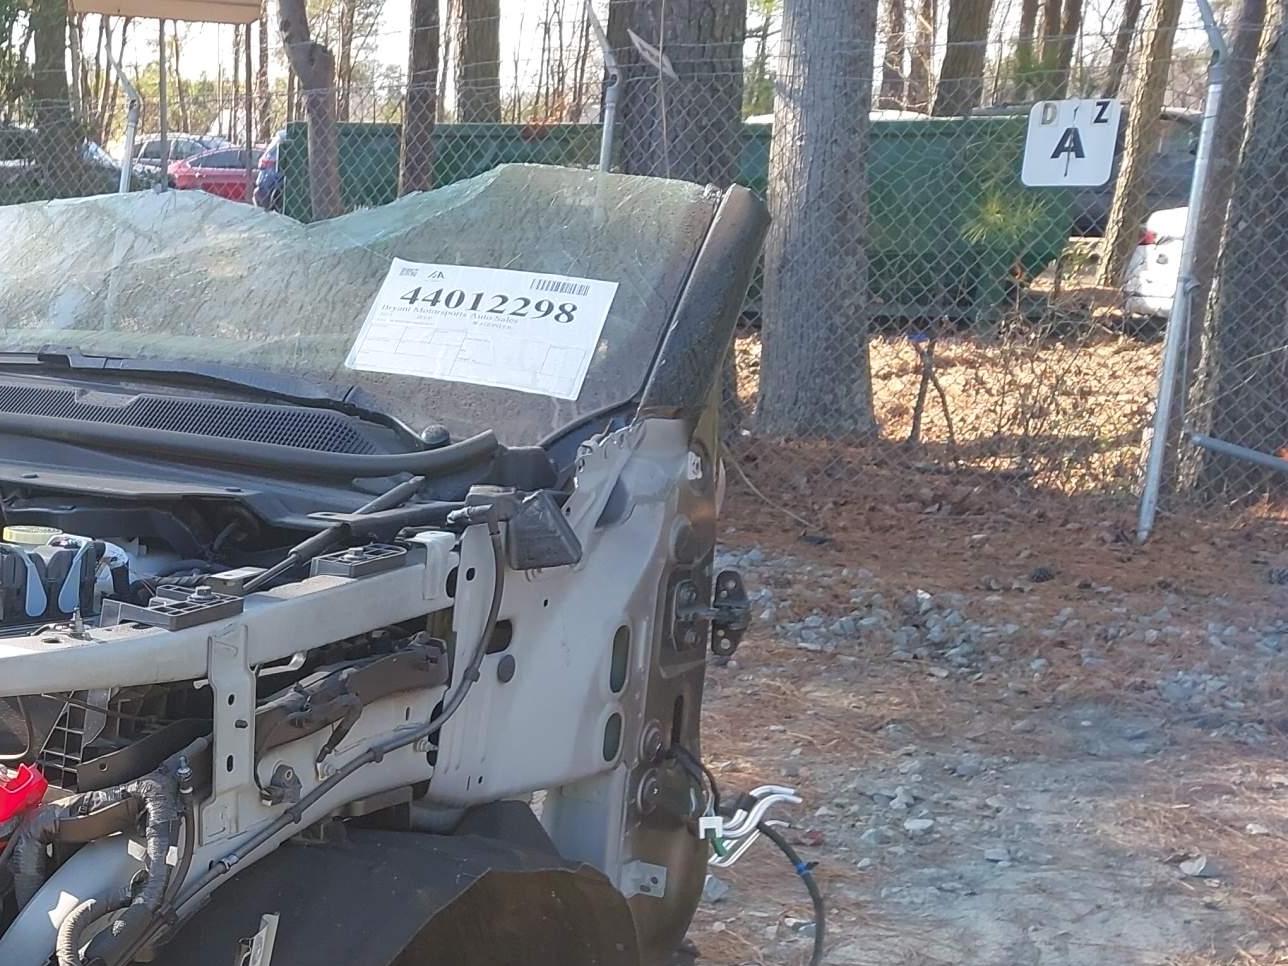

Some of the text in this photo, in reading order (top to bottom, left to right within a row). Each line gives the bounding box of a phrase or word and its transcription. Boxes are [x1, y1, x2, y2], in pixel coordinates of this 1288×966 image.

[1041, 101, 1111, 125] D Z
[1050, 127, 1085, 159] A
[399, 286, 578, 324] 44012298
